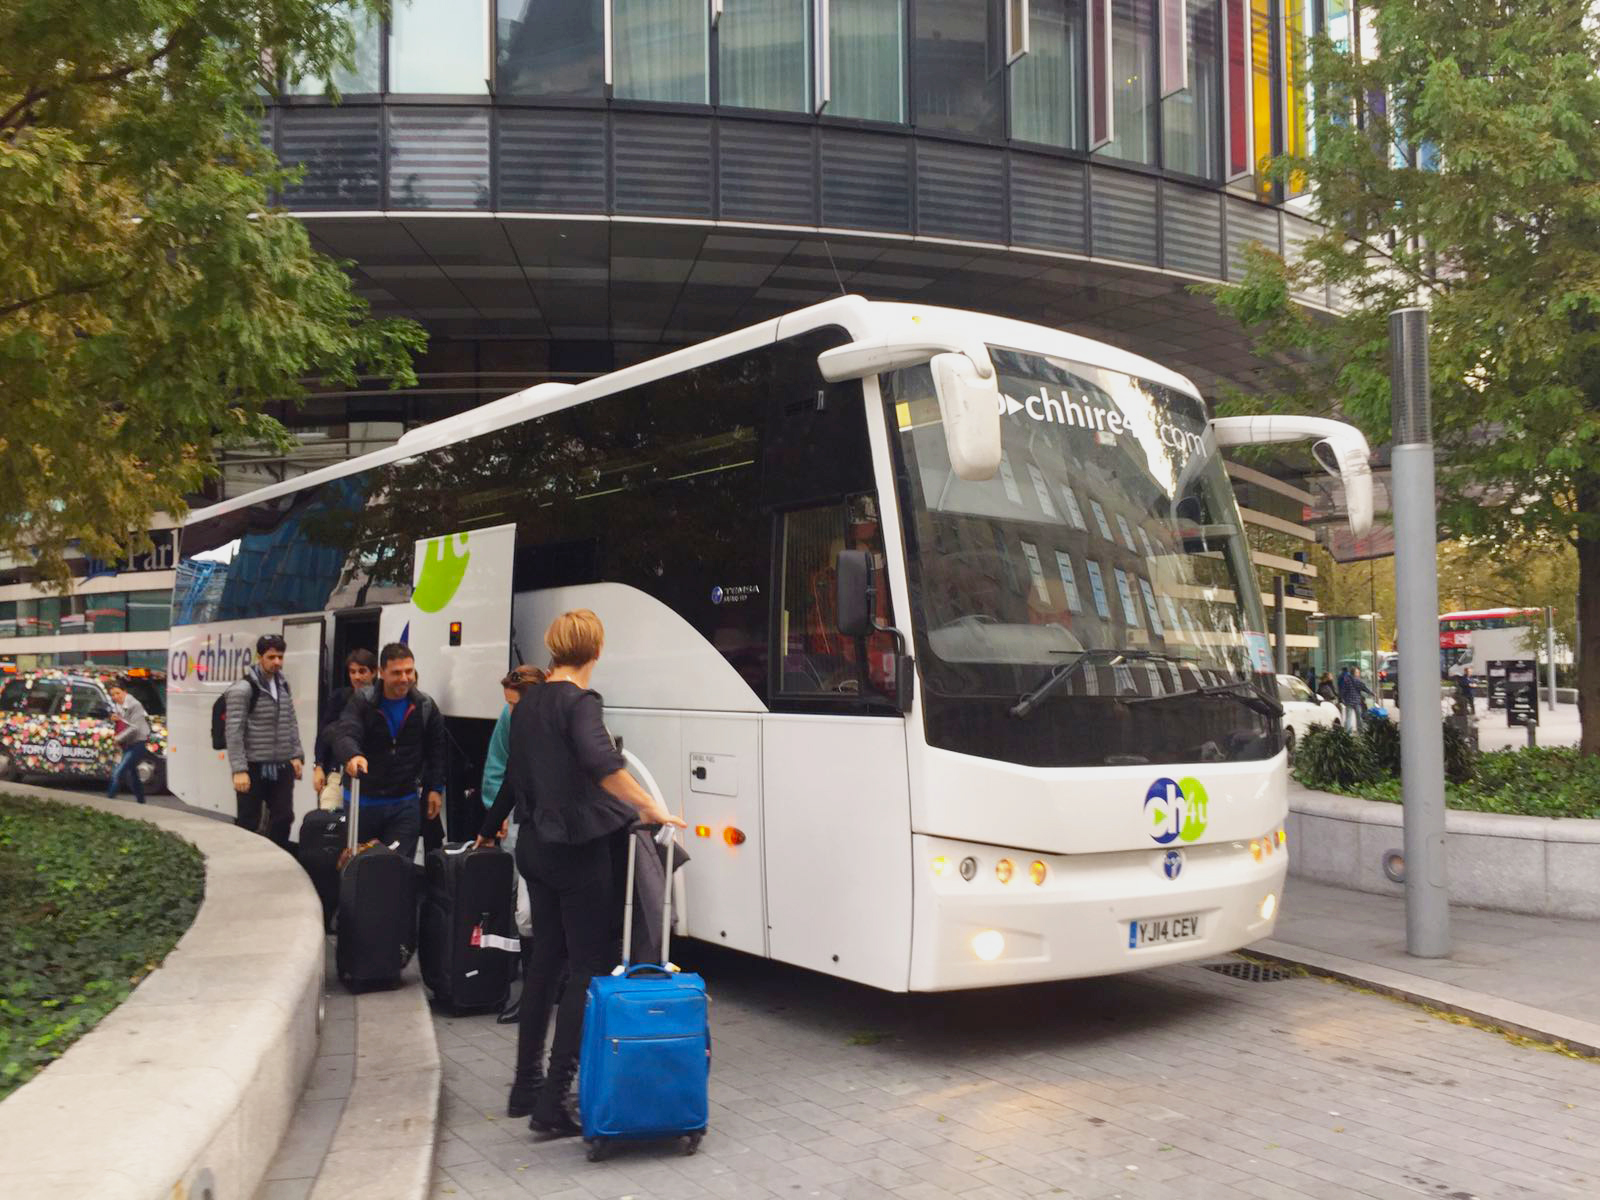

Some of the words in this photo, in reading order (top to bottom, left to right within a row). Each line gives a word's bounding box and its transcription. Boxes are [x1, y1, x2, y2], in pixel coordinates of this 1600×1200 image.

[21, 744, 46, 756] TORY
[62, 746, 99, 760] BURCH
[1139, 920, 1169, 944] YJ14
[1172, 916, 1199, 938] CEV
